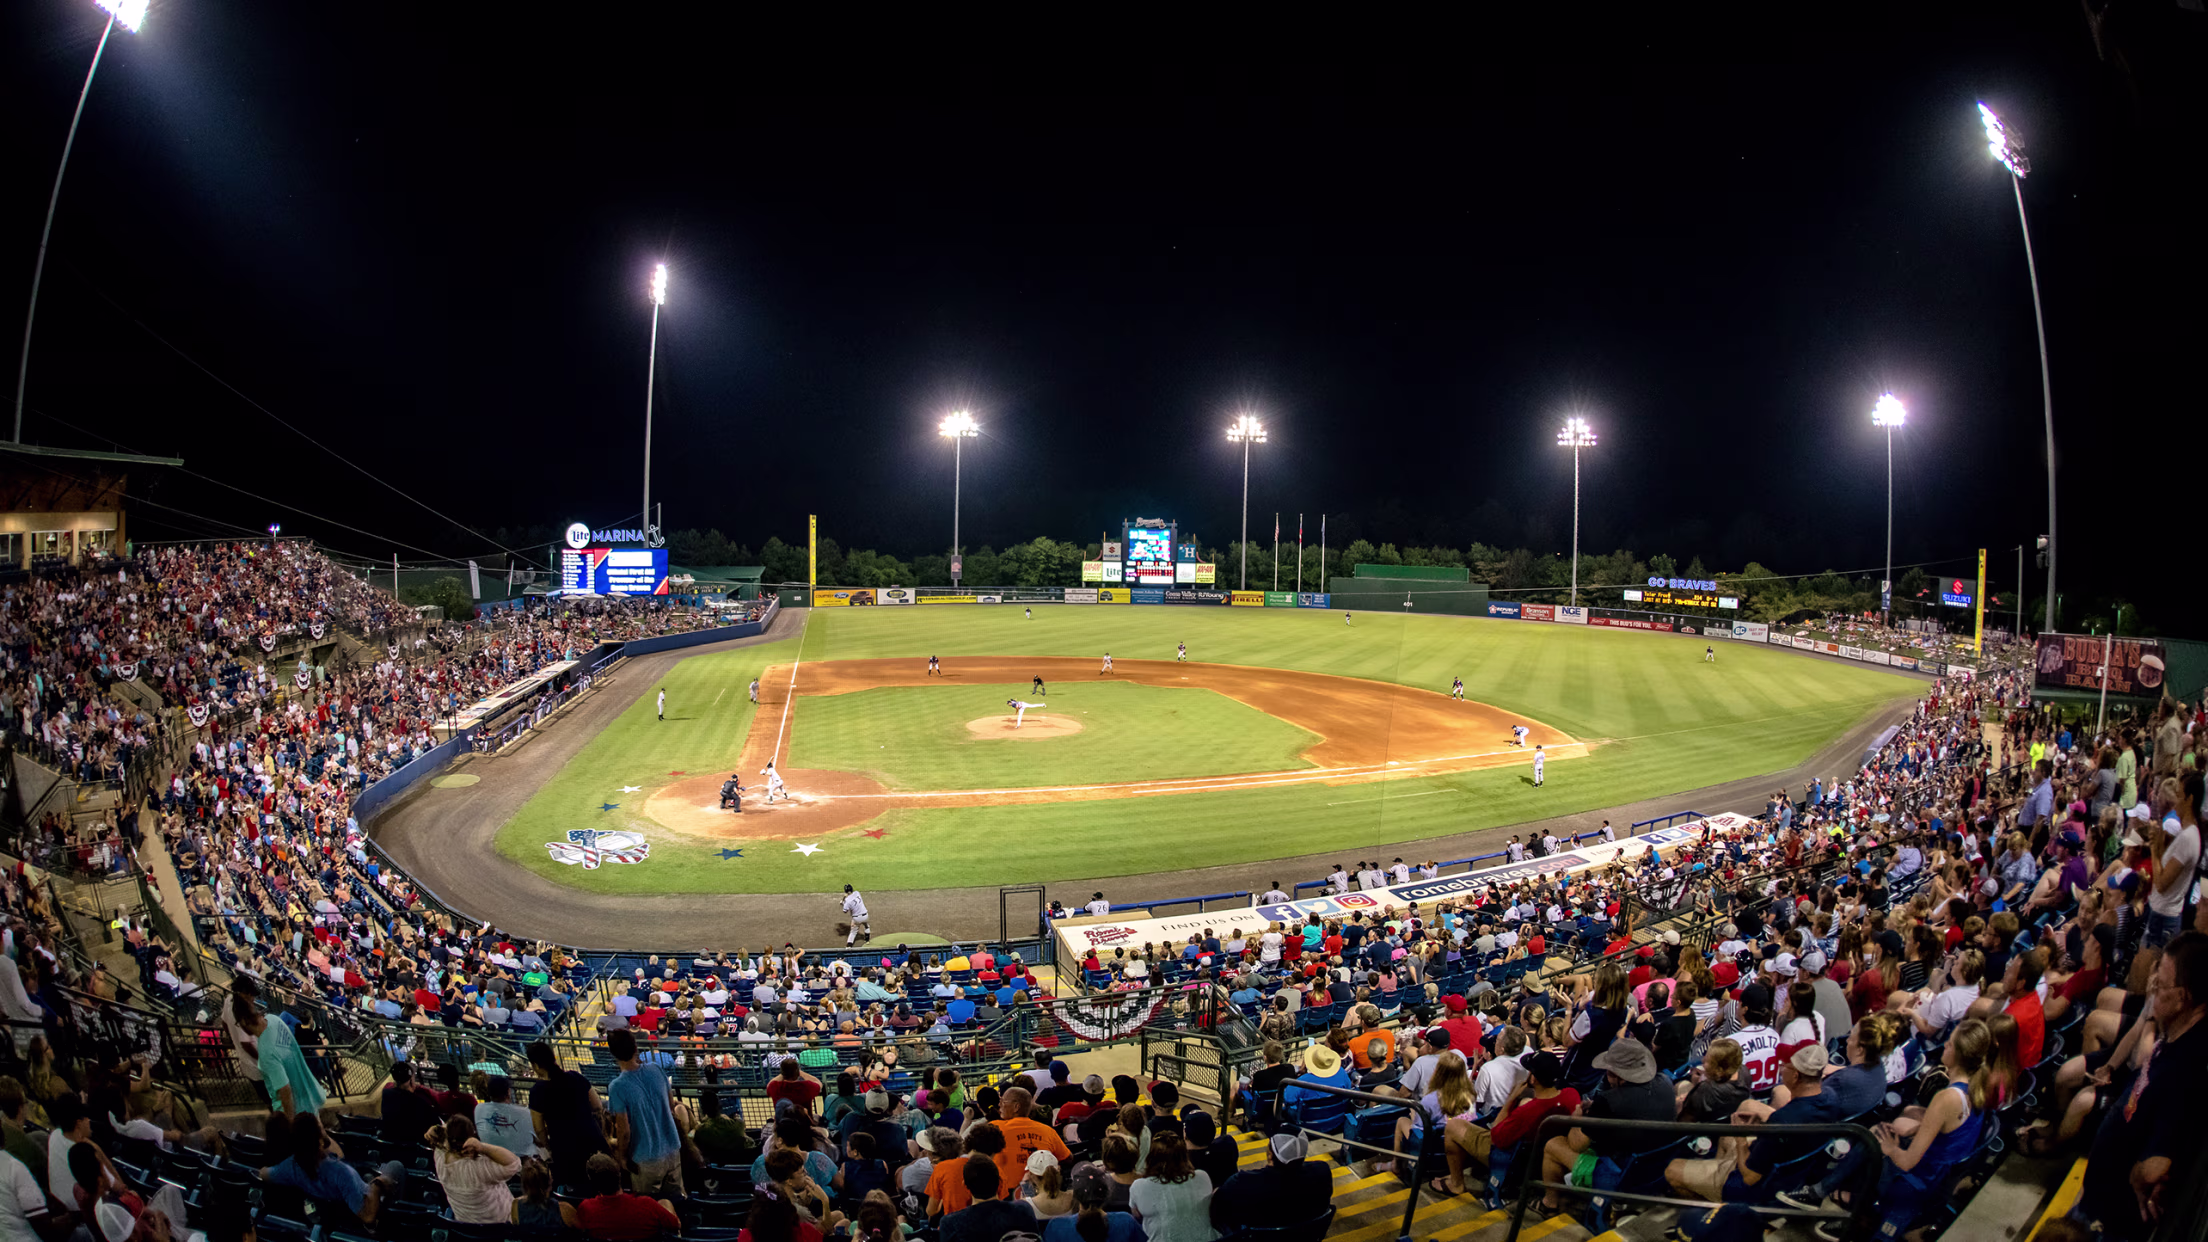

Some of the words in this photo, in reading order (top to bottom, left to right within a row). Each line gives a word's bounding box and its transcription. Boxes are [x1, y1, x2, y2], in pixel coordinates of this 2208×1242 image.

[572, 530, 590, 542] Lite
[592, 529, 646, 542] MARINA
[1106, 568, 1122, 577] Lite
[1648, 576, 1665, 587] GO
[1669, 578, 1717, 591] BRAVES
[1181, 591, 1196, 599] Valley
[1232, 594, 1264, 602] PIRELLI
[1943, 593, 1971, 603] SUZUKI
[1561, 606, 1581, 615] NGE
[2064, 637, 2140, 669] BUBBA'S
[2065, 674, 2132, 693] BARN
[1400, 851, 1584, 900] romebraves.com
[1161, 922, 1201, 931] FIND
[1230, 914, 1255, 922] ON
[1083, 927, 1121, 938] Rome
[1089, 933, 1129, 946] Braves
[1742, 1036, 1778, 1056] SMOLTZ
[1745, 1056, 1780, 1091] 29
